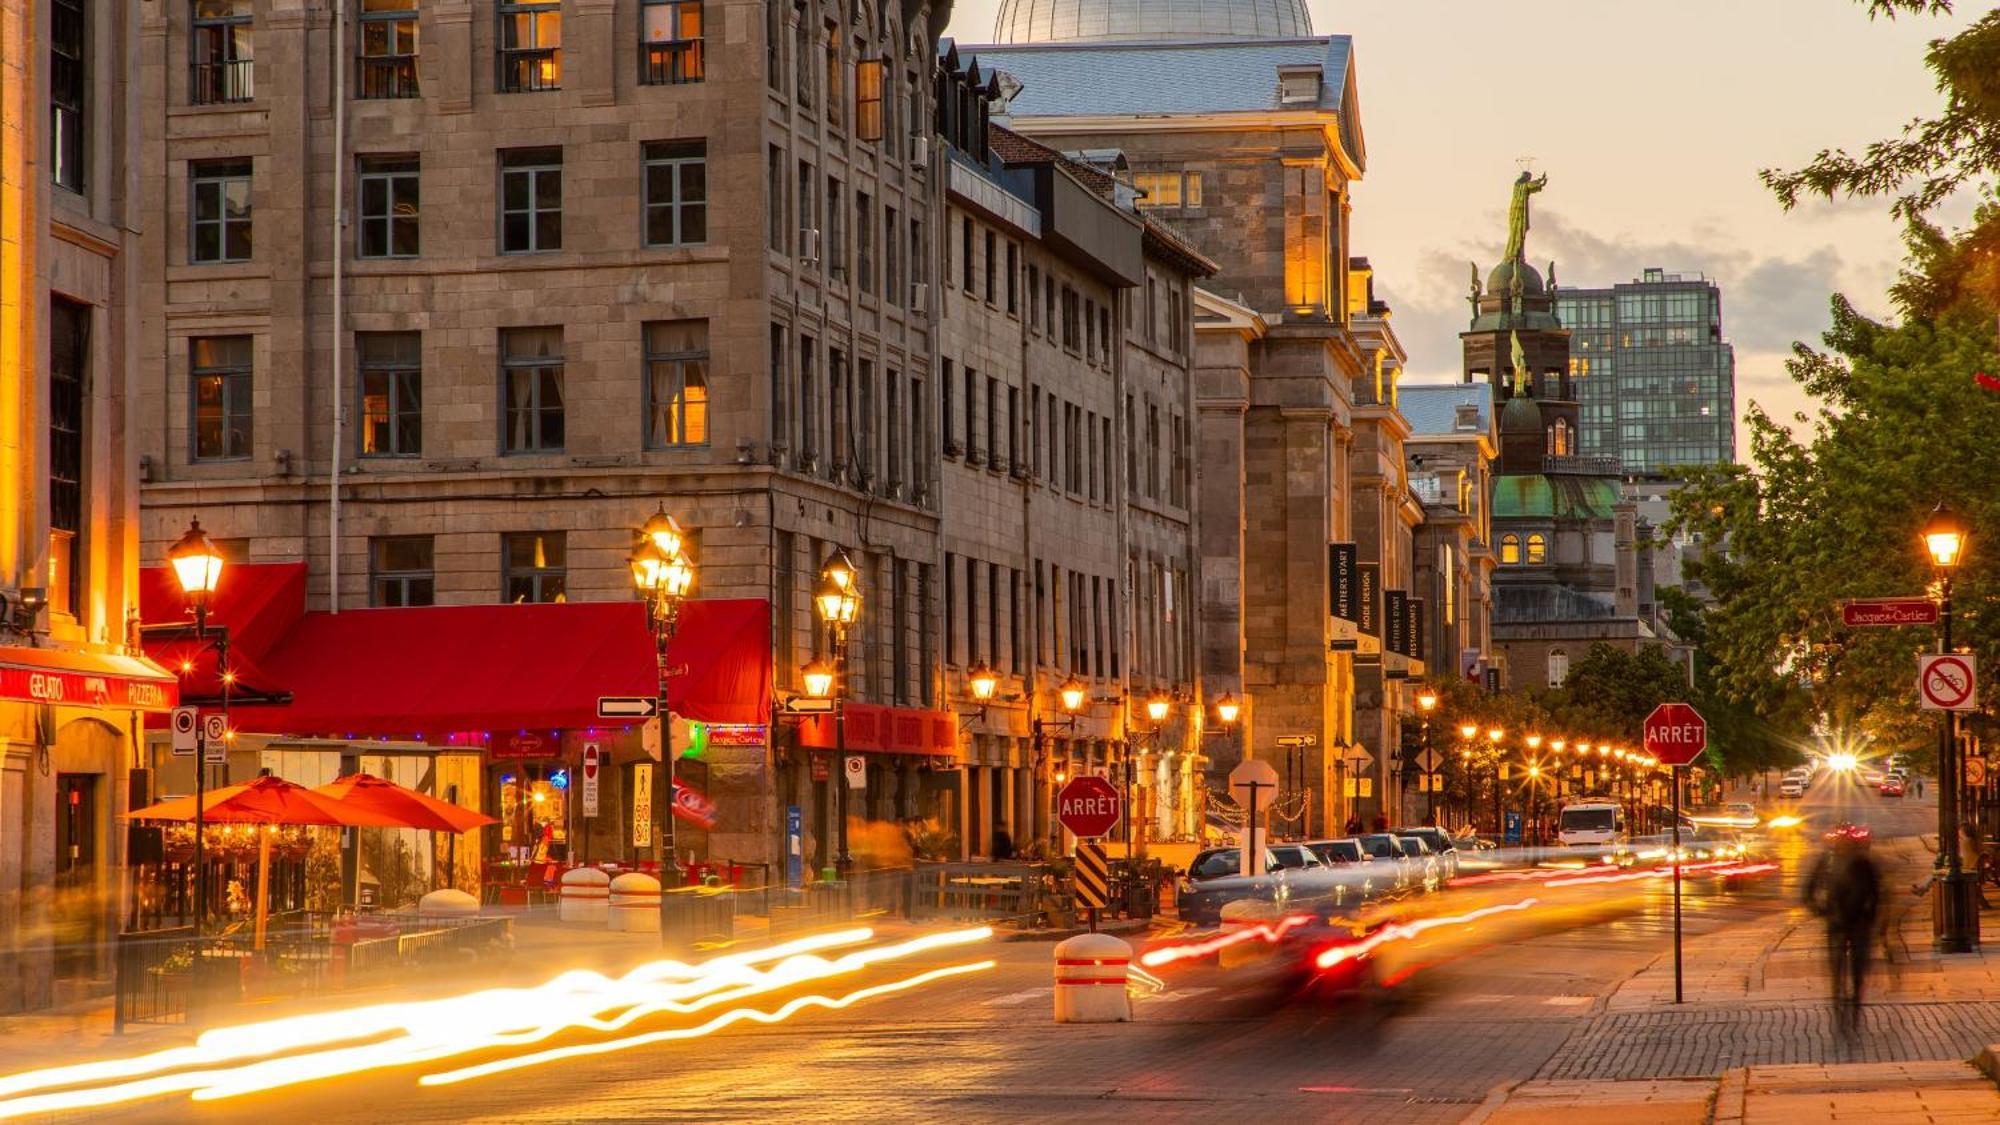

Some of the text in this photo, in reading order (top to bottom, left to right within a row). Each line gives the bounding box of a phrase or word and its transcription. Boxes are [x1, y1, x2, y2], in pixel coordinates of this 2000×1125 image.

[1338, 550, 1348, 617] MÉTIERS D'ART
[1362, 571, 1371, 630] MODE DESIGN
[1409, 603, 1417, 657] RESTAURANTS
[30, 674, 64, 701] GELATO
[128, 683, 162, 705] PIZZERIA
[1648, 722, 1703, 744] ARRÊT
[1062, 794, 1117, 816] ARRÊT
